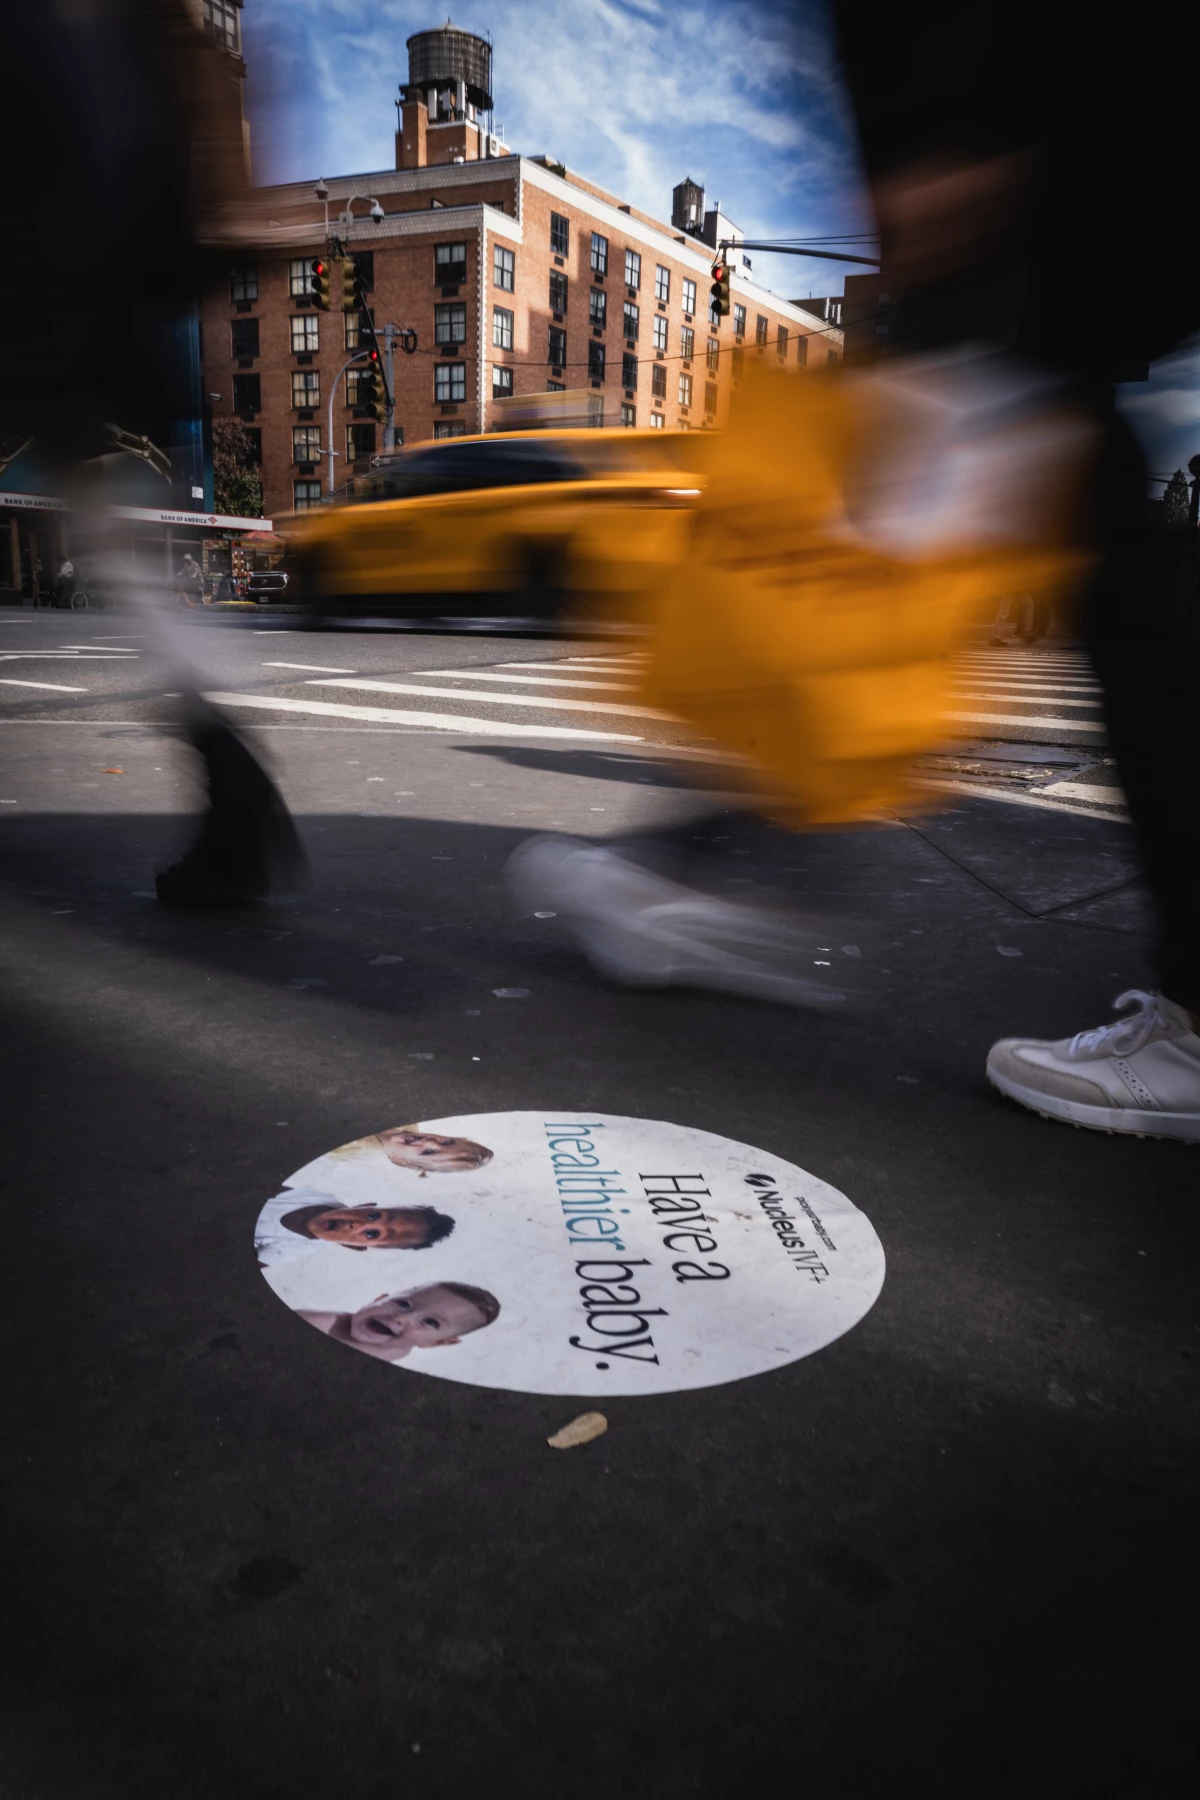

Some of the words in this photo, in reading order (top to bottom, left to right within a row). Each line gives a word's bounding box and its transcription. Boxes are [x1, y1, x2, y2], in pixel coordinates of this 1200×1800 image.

[160, 514, 176, 522] BANK
[184, 516, 208, 524] AMERICA
[543, 1122, 631, 1251] healthier
[638, 1172, 718, 1253] Have
[671, 1261, 731, 1284] a
[753, 1190, 805, 1248] Nucleus
[786, 1250, 830, 1284] IVF+
[569, 1258, 670, 1370] baby.
